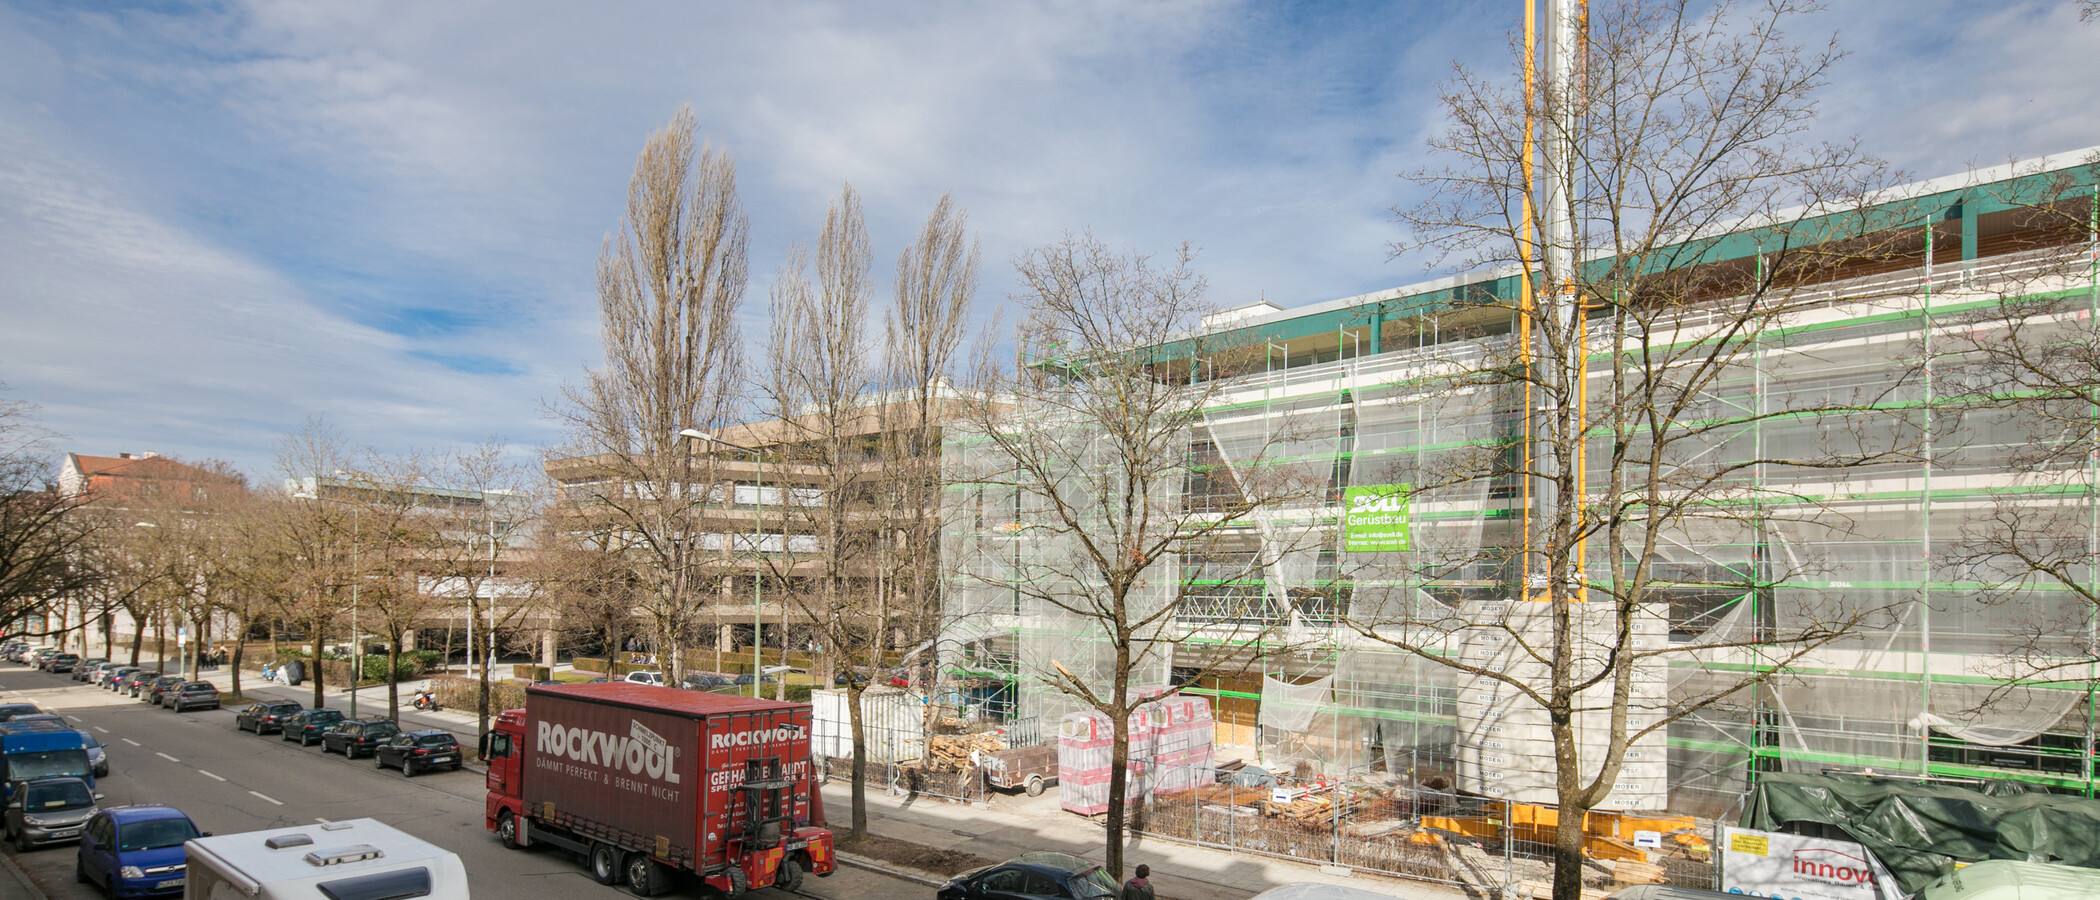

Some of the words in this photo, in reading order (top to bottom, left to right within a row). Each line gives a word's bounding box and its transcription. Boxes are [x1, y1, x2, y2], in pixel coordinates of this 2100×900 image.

[1348, 513, 1407, 526] Gerüstbau
[536, 757, 564, 774] DÄMMT
[565, 764, 599, 782] PERFEKT
[603, 773, 610, 785] &
[615, 776, 649, 795] BRENNT
[651, 785, 680, 803] NICHT
